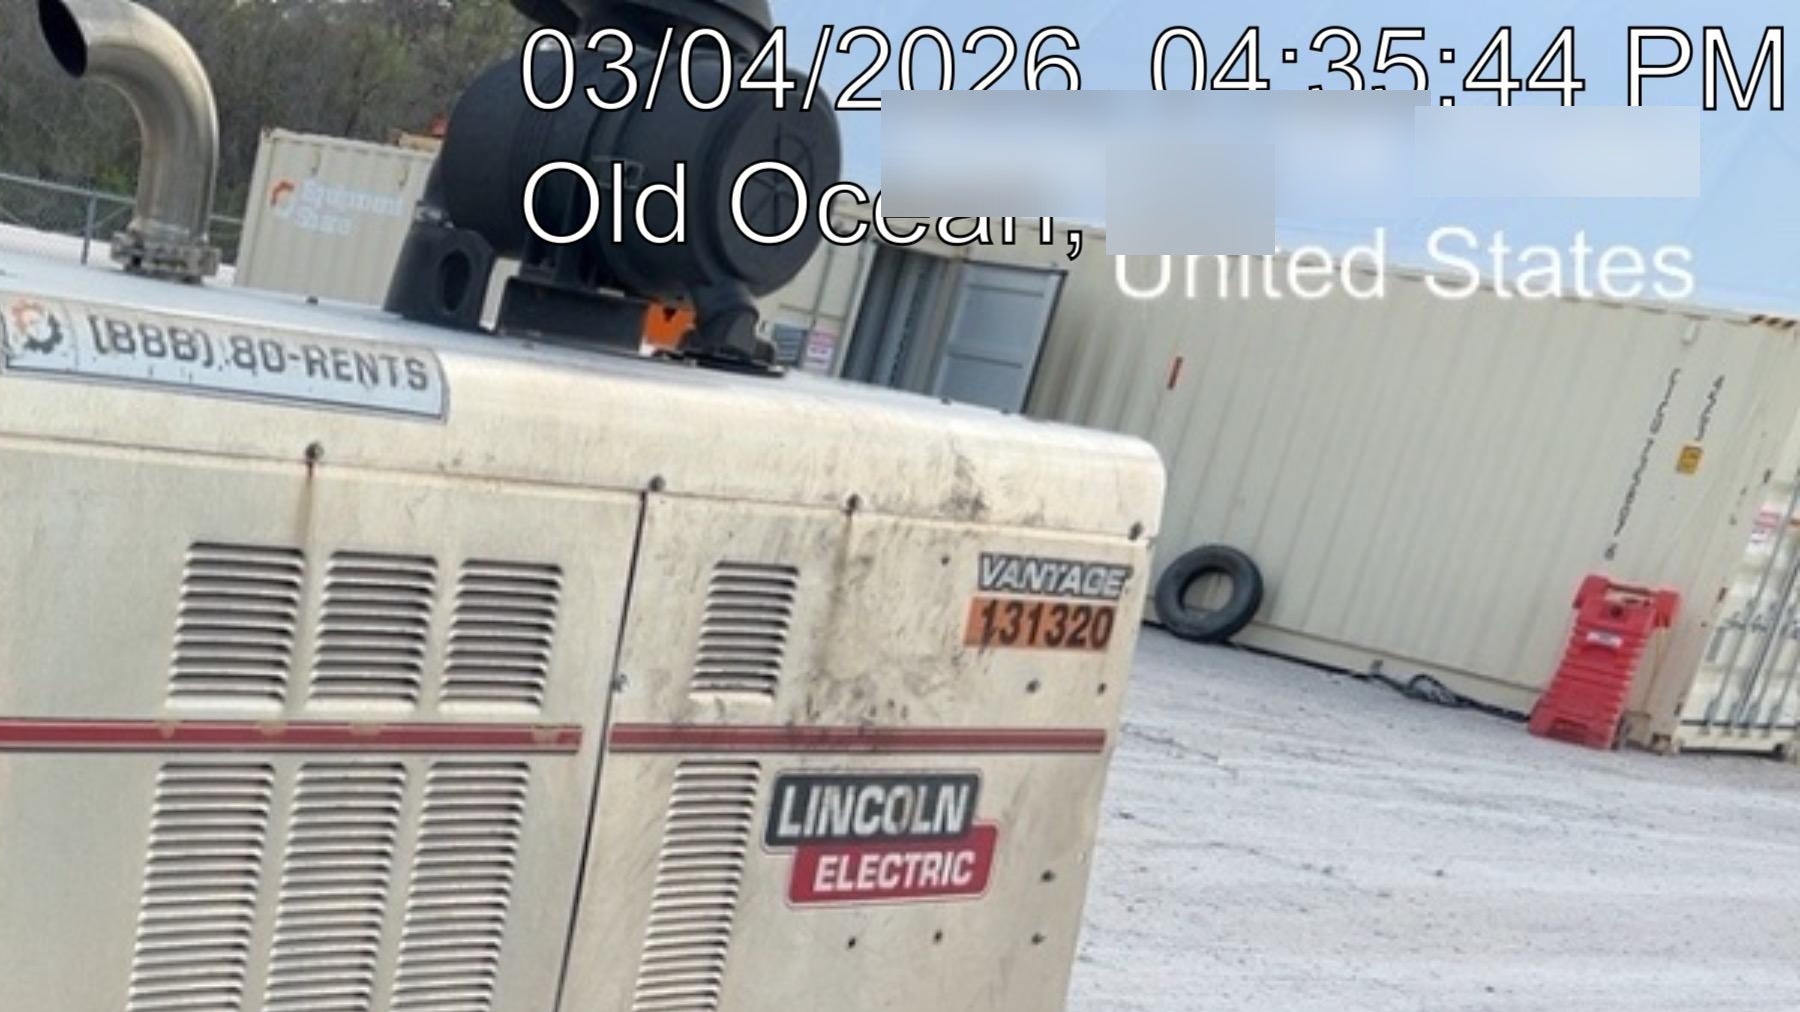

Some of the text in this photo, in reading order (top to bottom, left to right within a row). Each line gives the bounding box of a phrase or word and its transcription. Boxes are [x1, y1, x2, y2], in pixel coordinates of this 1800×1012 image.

[231, 333, 429, 391] 80-RENTS
[979, 555, 1127, 597] VANTAGE
[979, 600, 1117, 650] 131320
[776, 784, 972, 837] LINCOLN
[812, 850, 976, 893] ELECTRIC
